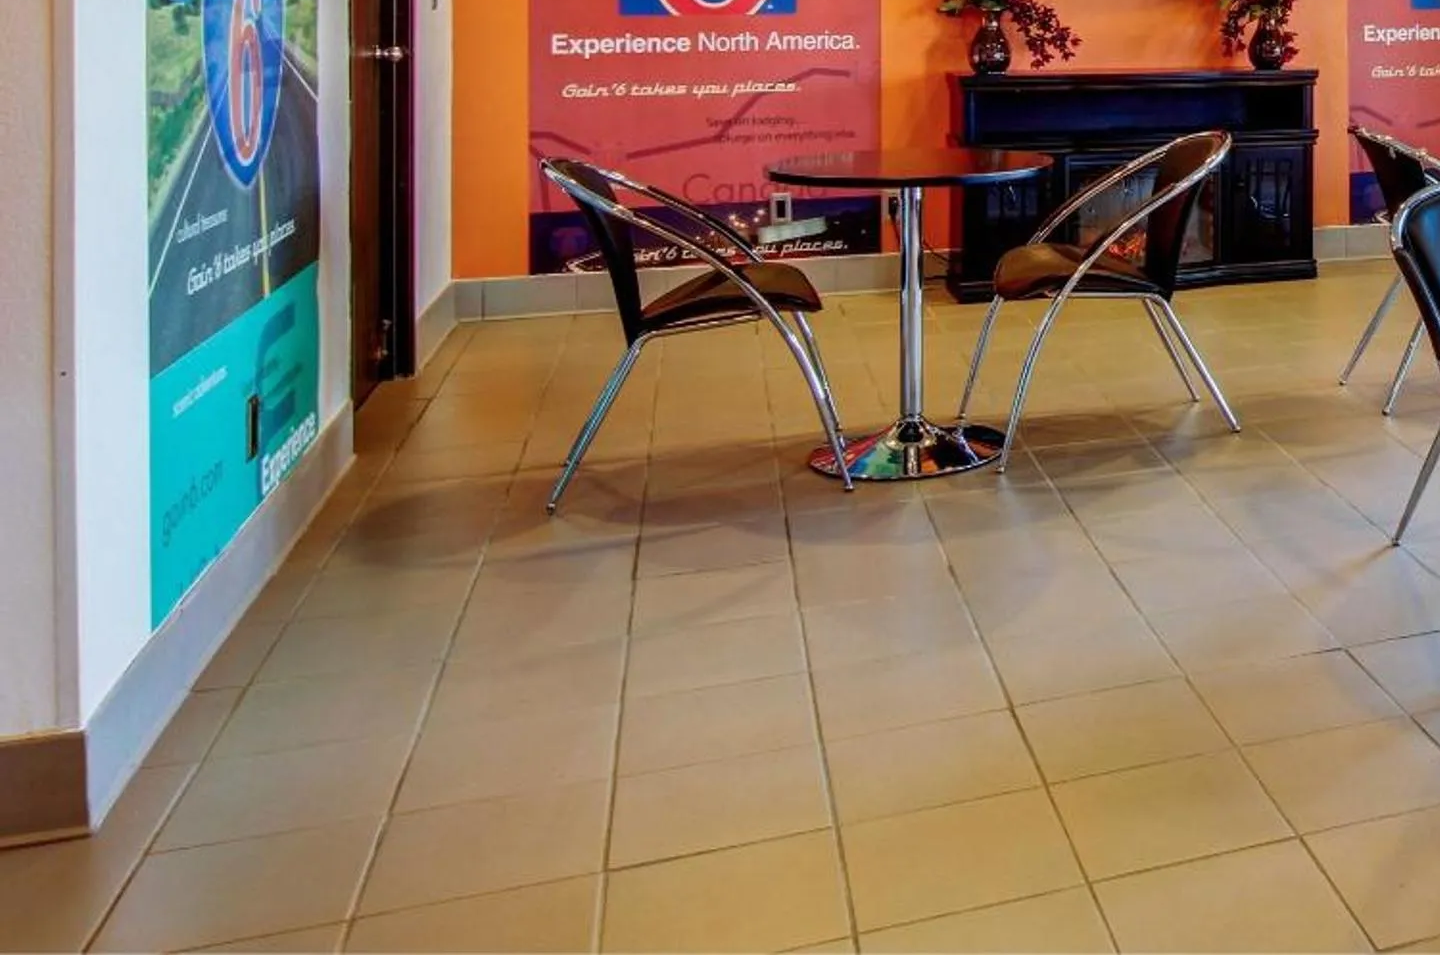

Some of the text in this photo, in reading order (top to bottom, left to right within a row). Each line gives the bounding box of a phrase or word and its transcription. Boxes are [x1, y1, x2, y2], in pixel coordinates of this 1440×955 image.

[551, 30, 861, 59] Experience North America.
[561, 80, 801, 99] Goin'6 takes you places.
[779, 240, 849, 258] places.
[261, 412, 316, 496] Experience
